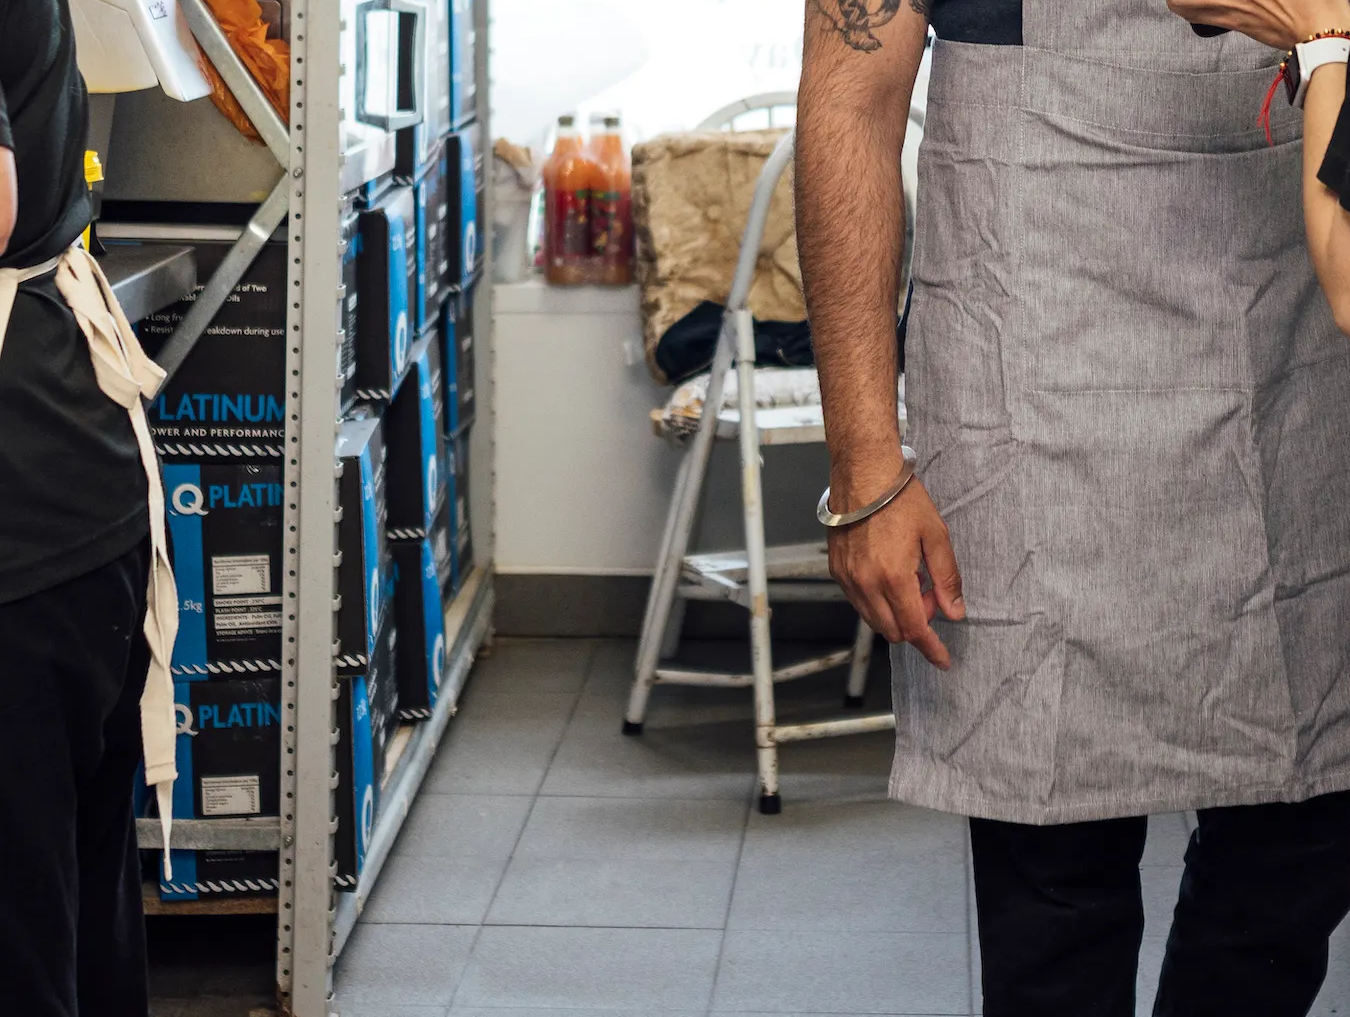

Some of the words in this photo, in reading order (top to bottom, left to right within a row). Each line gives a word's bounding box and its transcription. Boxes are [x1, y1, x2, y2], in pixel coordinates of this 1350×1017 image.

[242, 284, 251, 292] of
[251, 284, 268, 293] Two
[151, 313, 171, 323] Long
[243, 327, 270, 338] during
[271, 328, 285, 336] use
[151, 427, 181, 437] OWER
[184, 428, 207, 437] AND
[210, 428, 285, 438] PERFORMANC
[172, 483, 209, 516] Q
[209, 483, 284, 508] PLATI
[179, 599, 203, 614] .5kg
[199, 702, 281, 729] PLATIN
